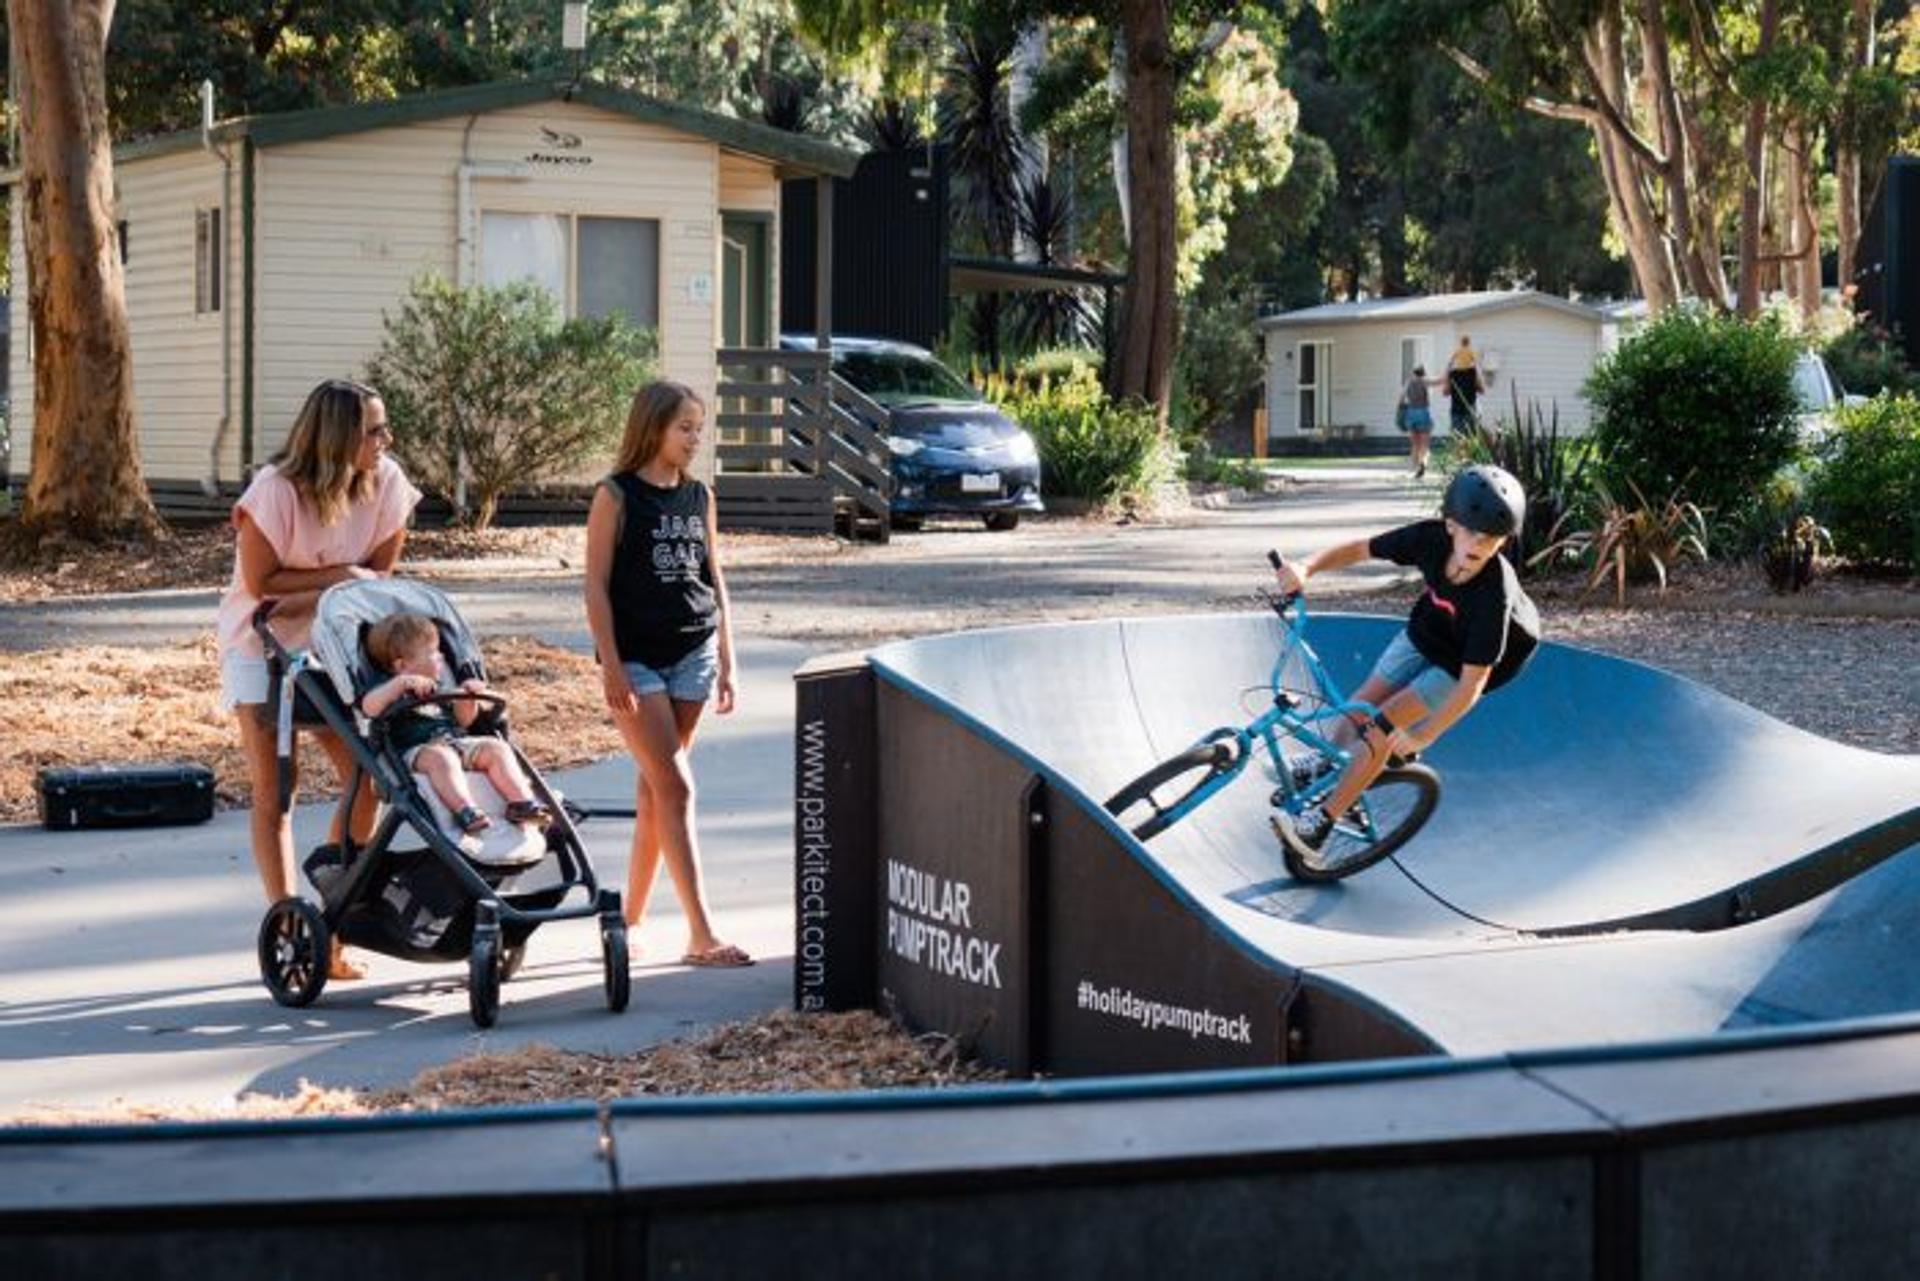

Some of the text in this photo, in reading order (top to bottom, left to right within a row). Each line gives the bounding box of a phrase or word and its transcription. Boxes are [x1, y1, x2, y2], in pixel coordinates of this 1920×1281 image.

[525, 153, 593, 166] Jayco
[888, 857, 971, 929] MODULAR
[888, 907, 1002, 989] PUMPTRACK
[1077, 979, 1252, 1044] #holidaypumptrack
